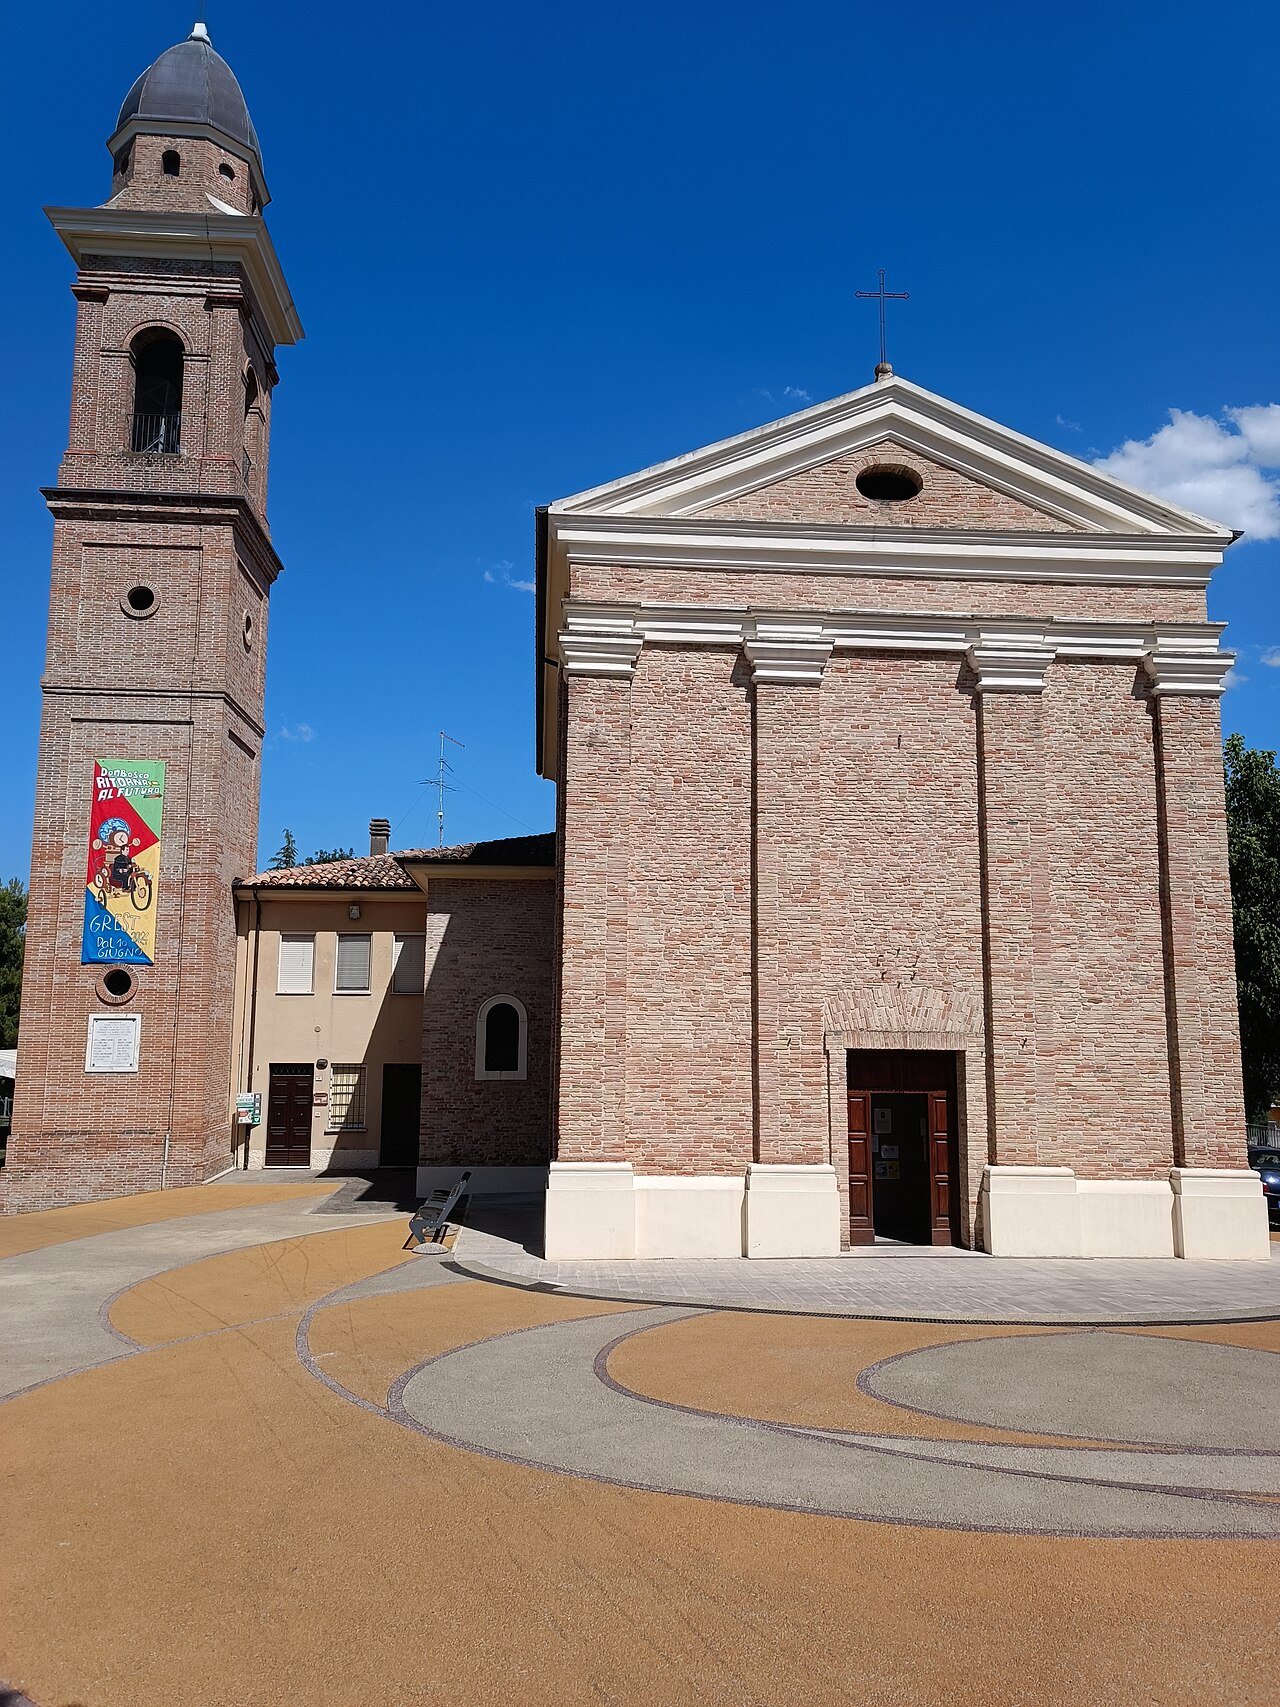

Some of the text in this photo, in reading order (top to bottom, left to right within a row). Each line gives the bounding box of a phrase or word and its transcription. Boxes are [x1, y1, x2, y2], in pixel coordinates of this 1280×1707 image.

[98, 787, 160, 802] AL FUTURO
[90, 912, 141, 933] GREST
[116, 938, 128, 947] 10
[97, 946, 143, 958] GIUGNO
